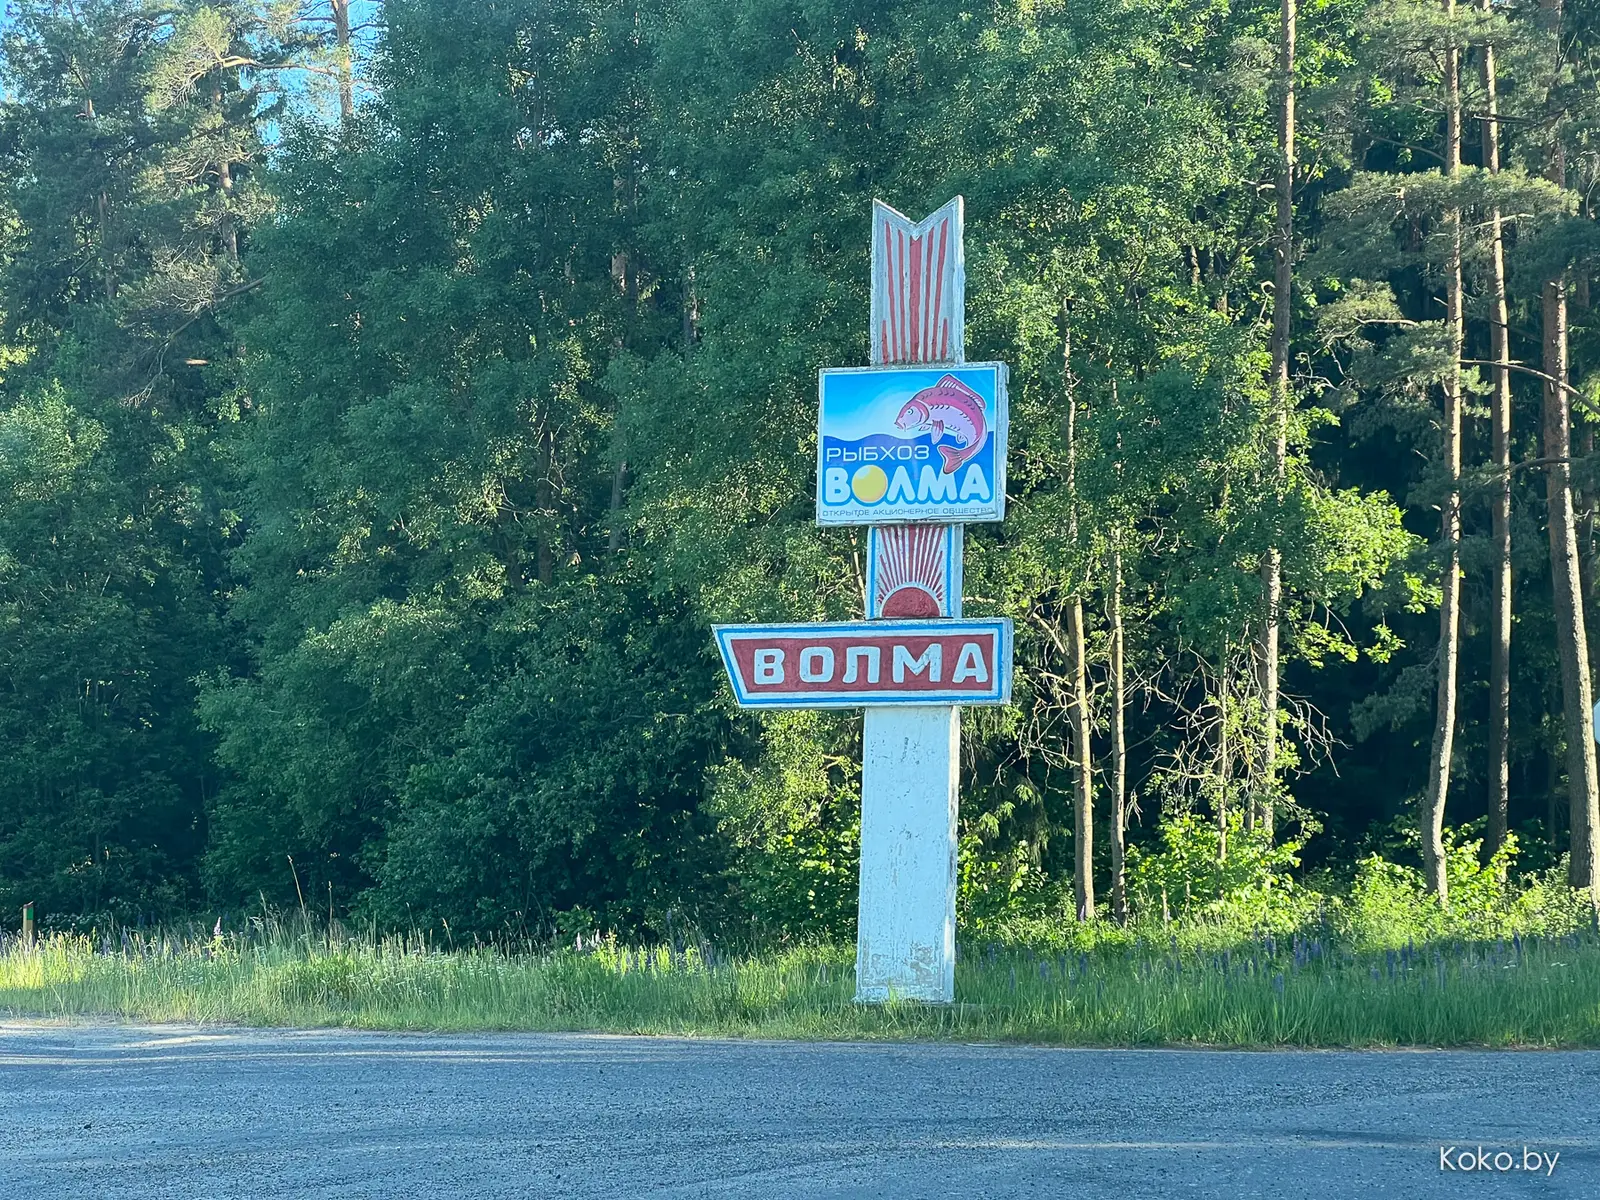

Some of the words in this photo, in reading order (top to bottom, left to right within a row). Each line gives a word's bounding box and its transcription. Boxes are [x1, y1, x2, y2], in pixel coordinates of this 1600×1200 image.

[826, 445, 930, 462] РЫБХОЗ
[825, 463, 990, 503] ВОЛМА
[822, 509, 870, 517] ОТКРЫТОЕ
[872, 507, 939, 516] АКЦИОНЕРНОЕ
[942, 506, 994, 515] ОБЩЕСТВО
[754, 642, 988, 685] ВОЛМА
